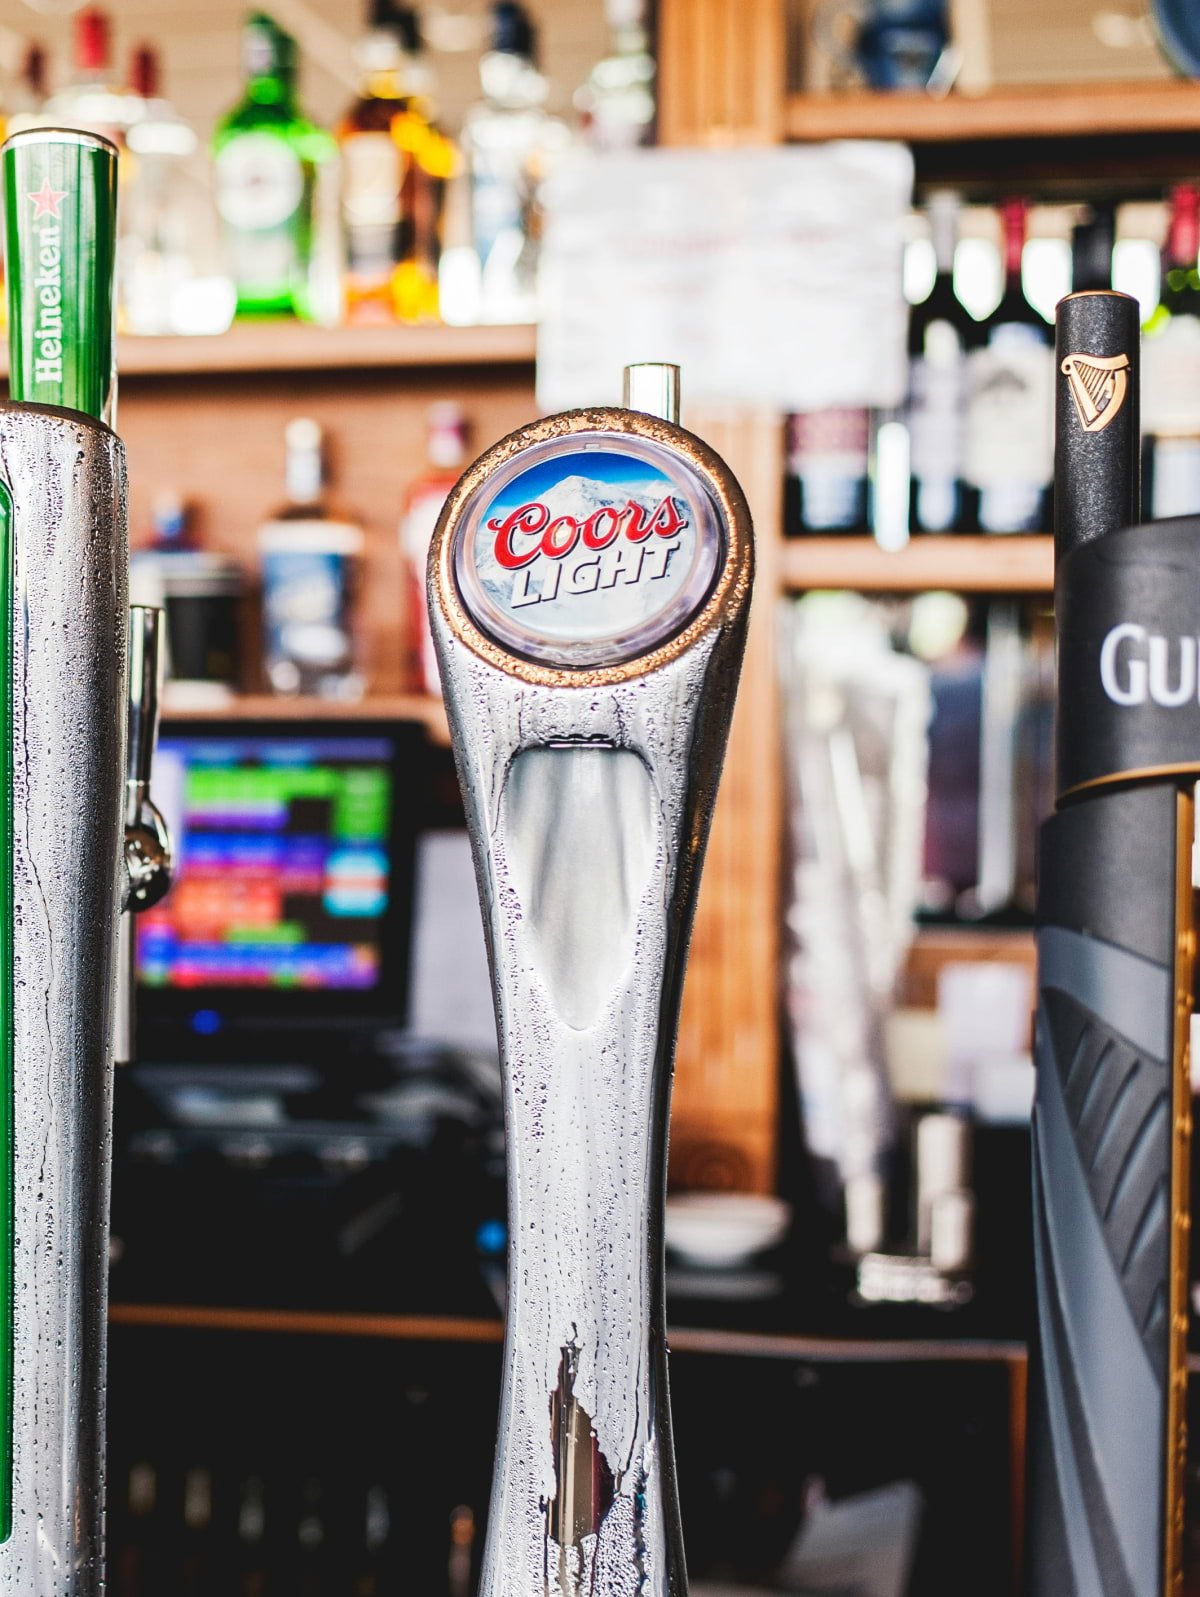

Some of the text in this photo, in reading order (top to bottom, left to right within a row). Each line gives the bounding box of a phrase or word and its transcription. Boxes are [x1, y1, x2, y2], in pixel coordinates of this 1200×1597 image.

[35, 225, 62, 383] Heineken
[487, 496, 687, 569] Coors
[511, 540, 680, 609] LIGHT
[1100, 622, 1200, 708] GU
